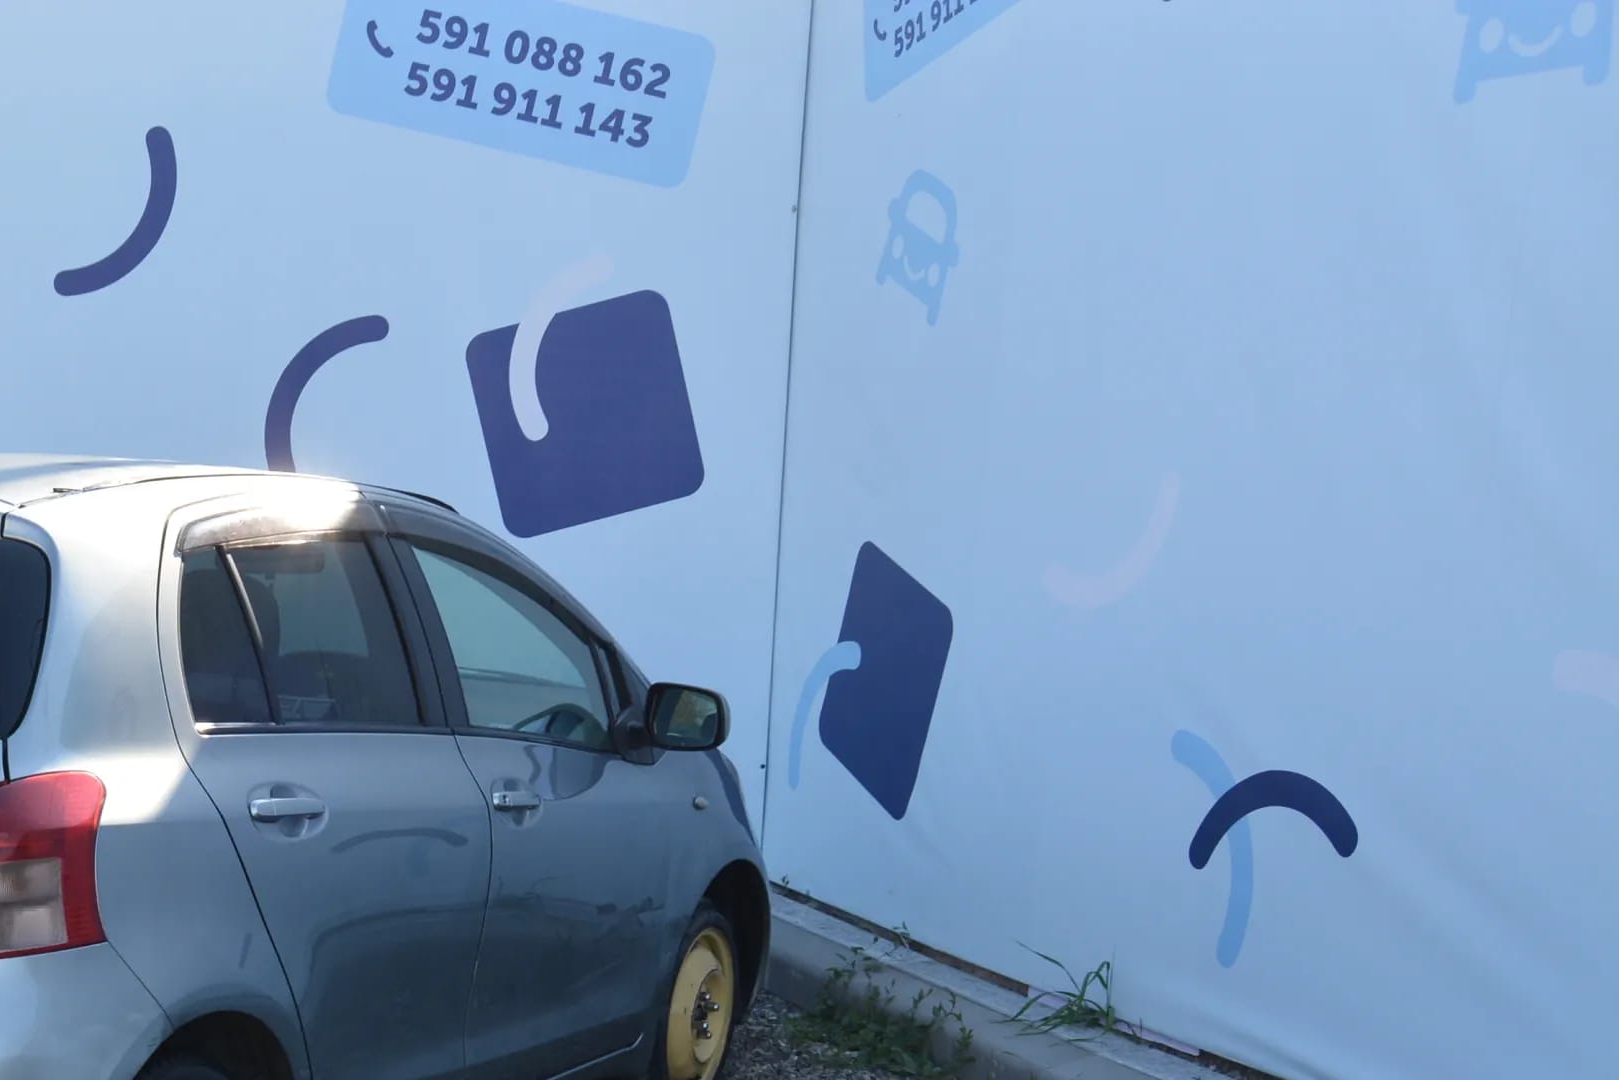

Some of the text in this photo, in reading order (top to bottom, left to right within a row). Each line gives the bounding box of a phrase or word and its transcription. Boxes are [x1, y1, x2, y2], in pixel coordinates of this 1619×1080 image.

[415, 8, 671, 100] 591 088 162
[894, 10, 926, 58] 591
[403, 61, 653, 149] 591 911 143
